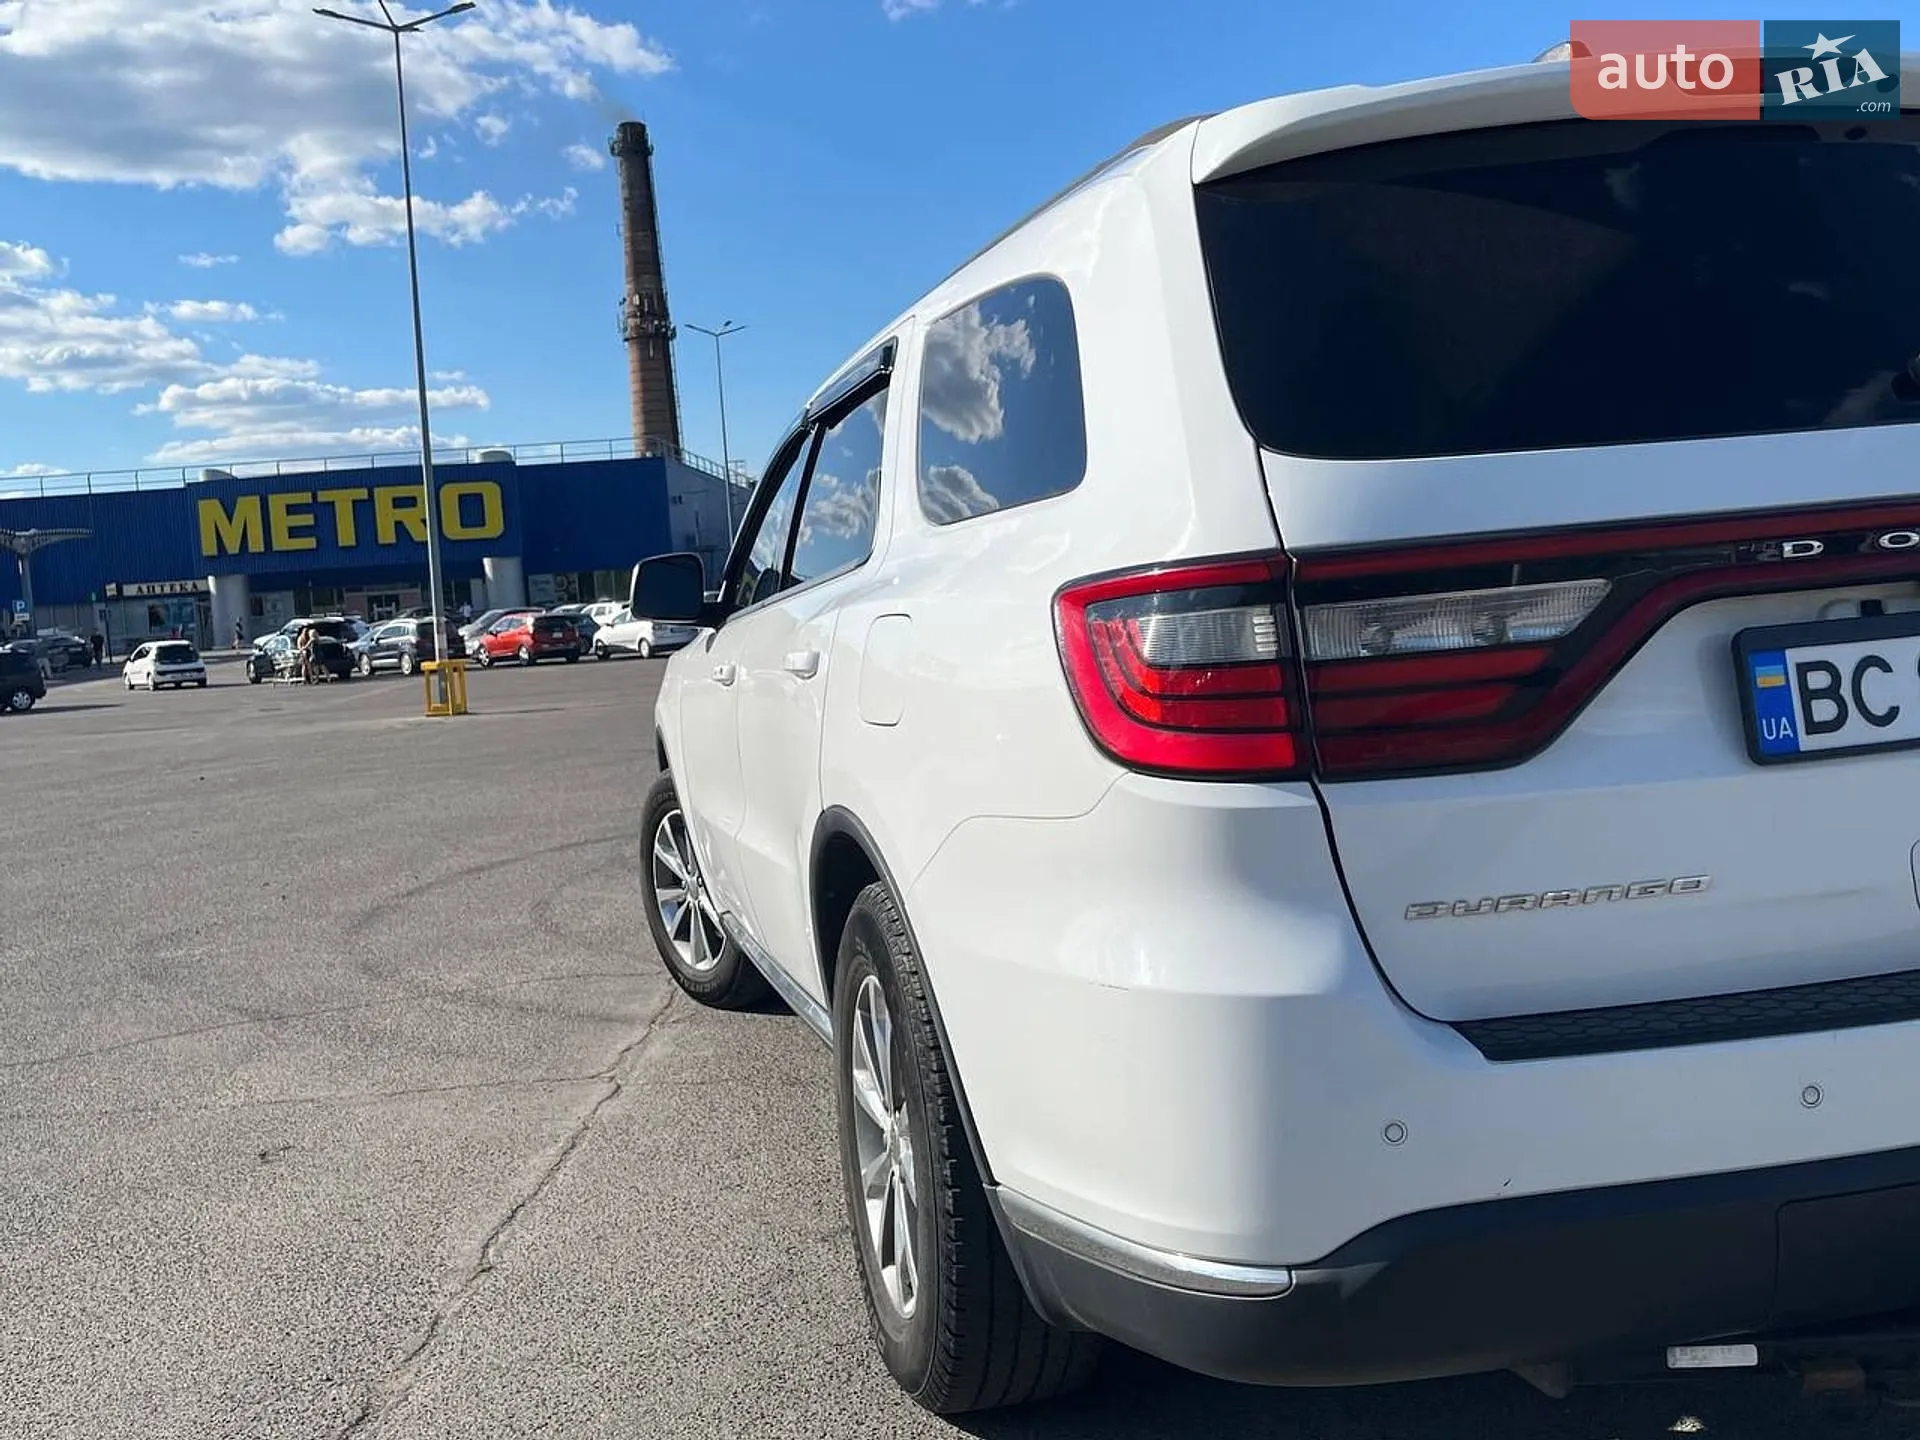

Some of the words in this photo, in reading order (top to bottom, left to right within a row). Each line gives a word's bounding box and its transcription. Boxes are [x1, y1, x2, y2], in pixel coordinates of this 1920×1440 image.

[199, 482, 504, 557] METRO
[136, 582, 199, 594] АПТЕКА
[1796, 655, 1900, 735] BC
[1762, 717, 1794, 740] UA
[1404, 875, 1712, 920] DURANGO
